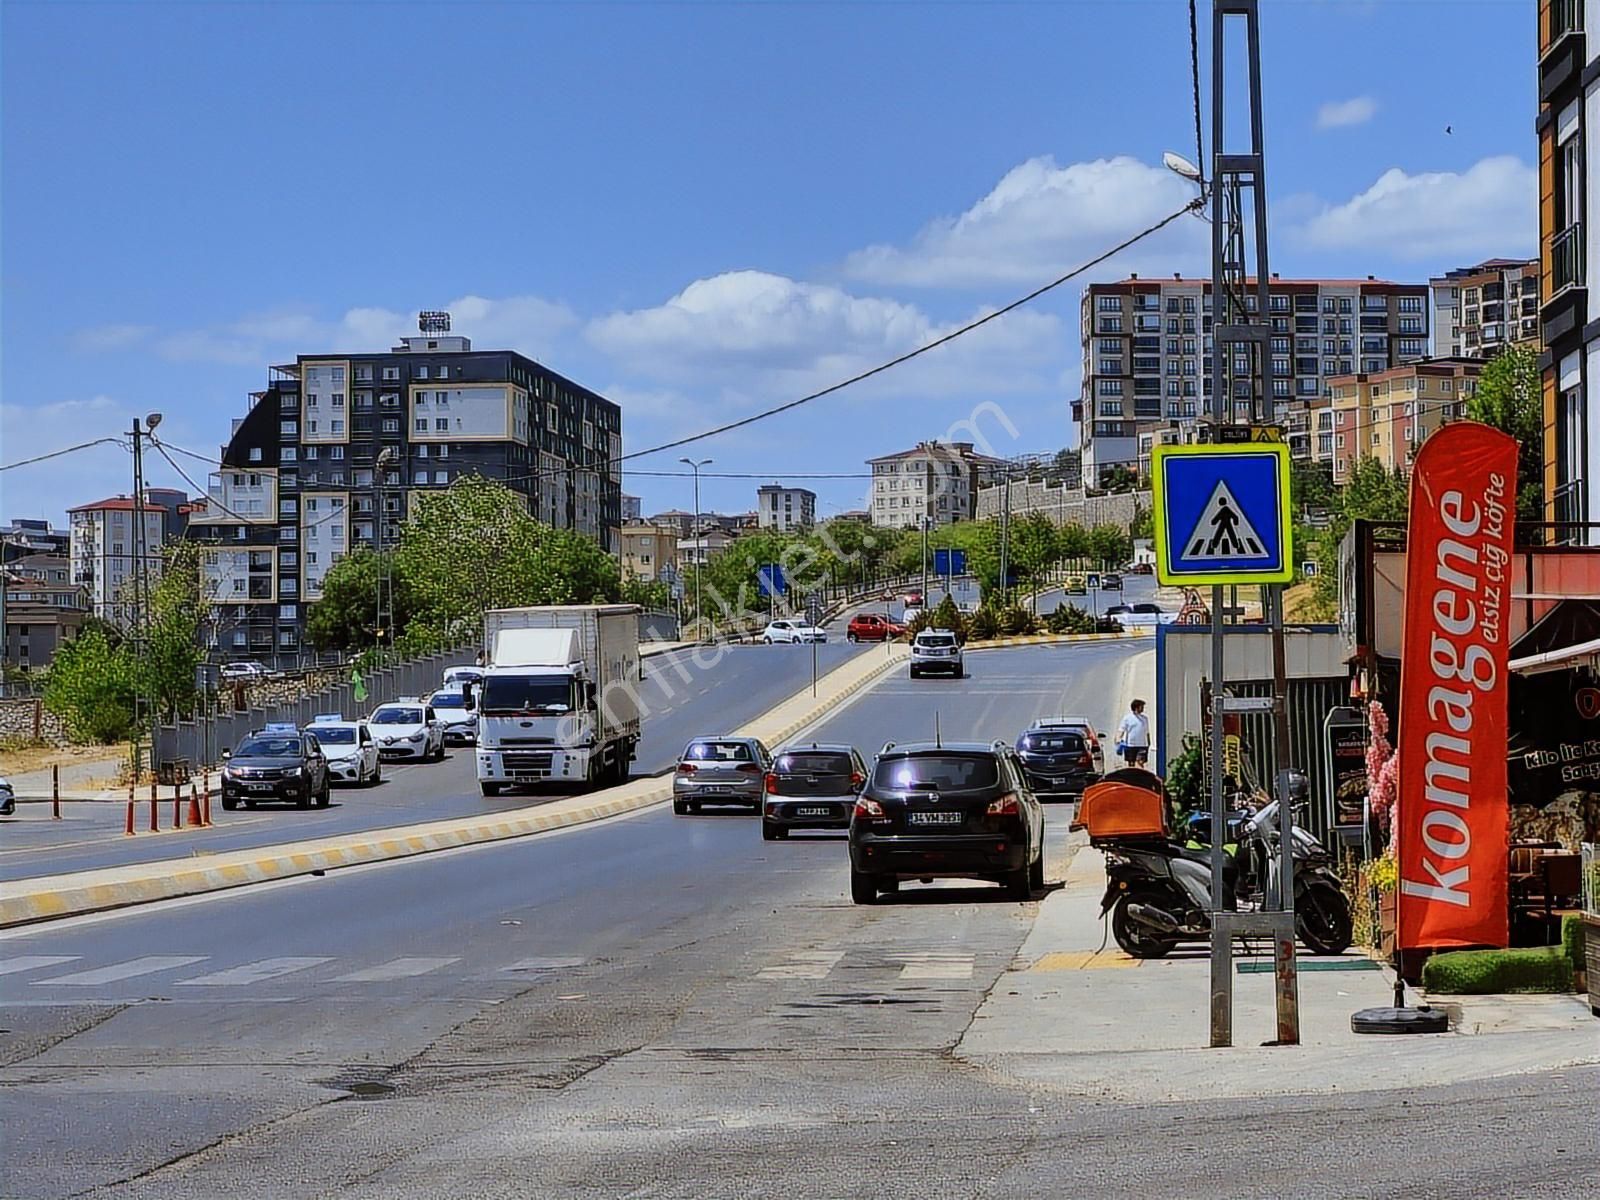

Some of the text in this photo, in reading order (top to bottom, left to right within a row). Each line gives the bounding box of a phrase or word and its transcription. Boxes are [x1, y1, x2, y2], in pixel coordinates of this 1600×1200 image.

[1401, 490, 1496, 907] komagene
[1480, 472, 1508, 643] etsiz çiğ köfte
